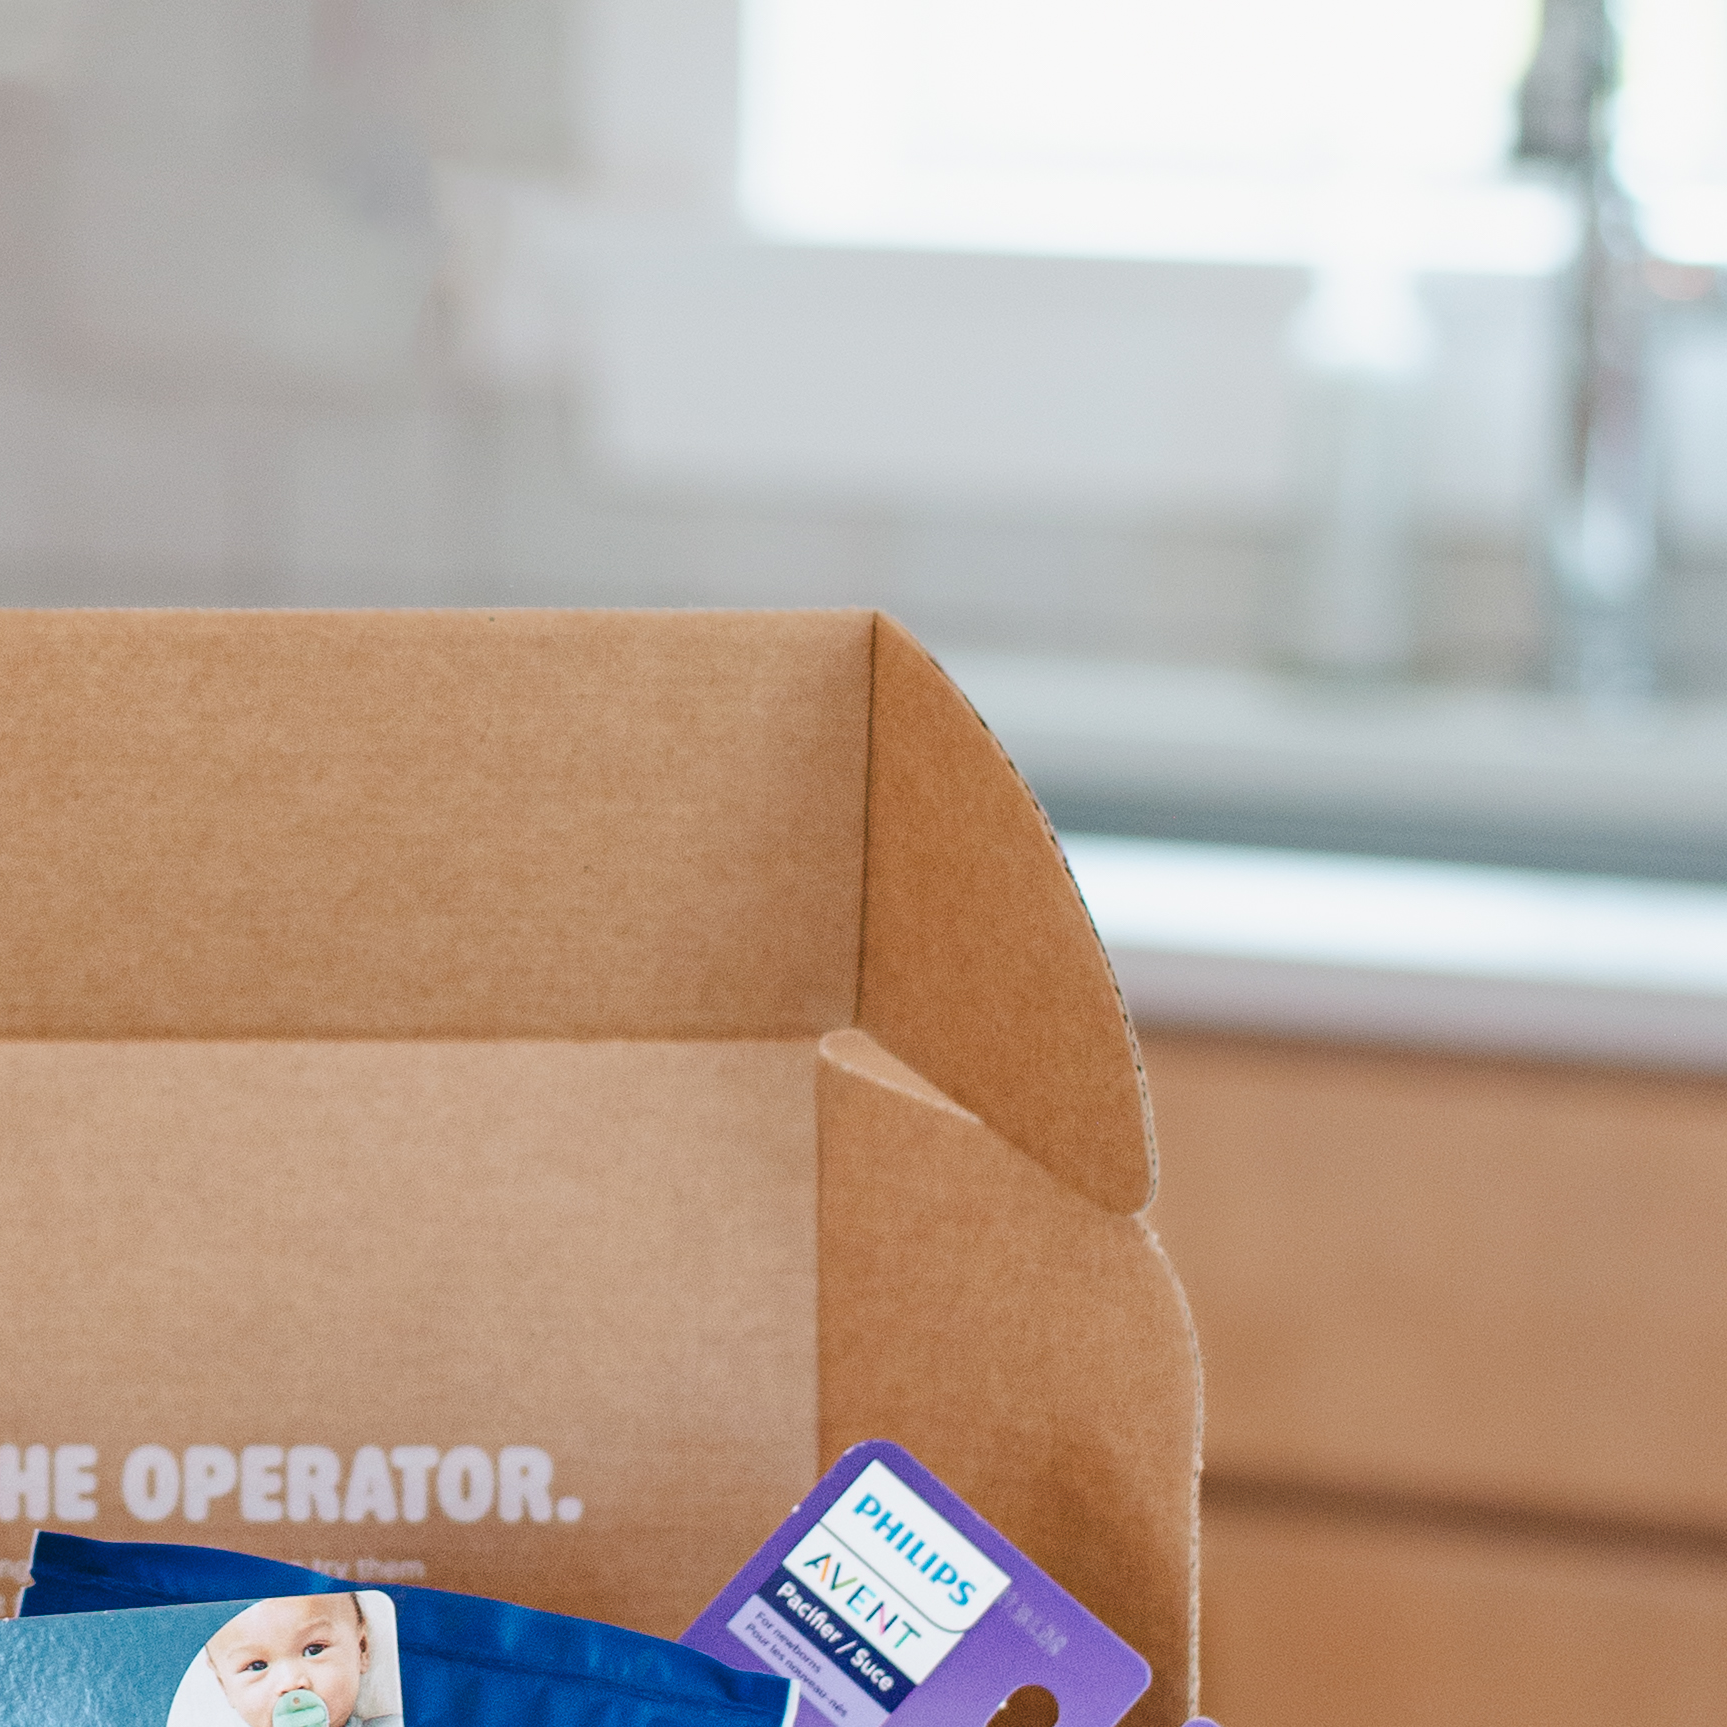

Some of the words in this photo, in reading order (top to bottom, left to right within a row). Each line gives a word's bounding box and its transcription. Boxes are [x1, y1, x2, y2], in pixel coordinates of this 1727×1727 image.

[122, 1444, 583, 1523] OPERATOR.
[853, 1493, 976, 1607] PHILIPS
[745, 1623, 774, 1653] Pour
[771, 1644, 787, 1665] les
[754, 1611, 776, 1635] For
[773, 1630, 821, 1674] newborns
[777, 1580, 843, 1644] Pacifier
[851, 1648, 894, 1691] Suce
[803, 1553, 921, 1649] AVENT
